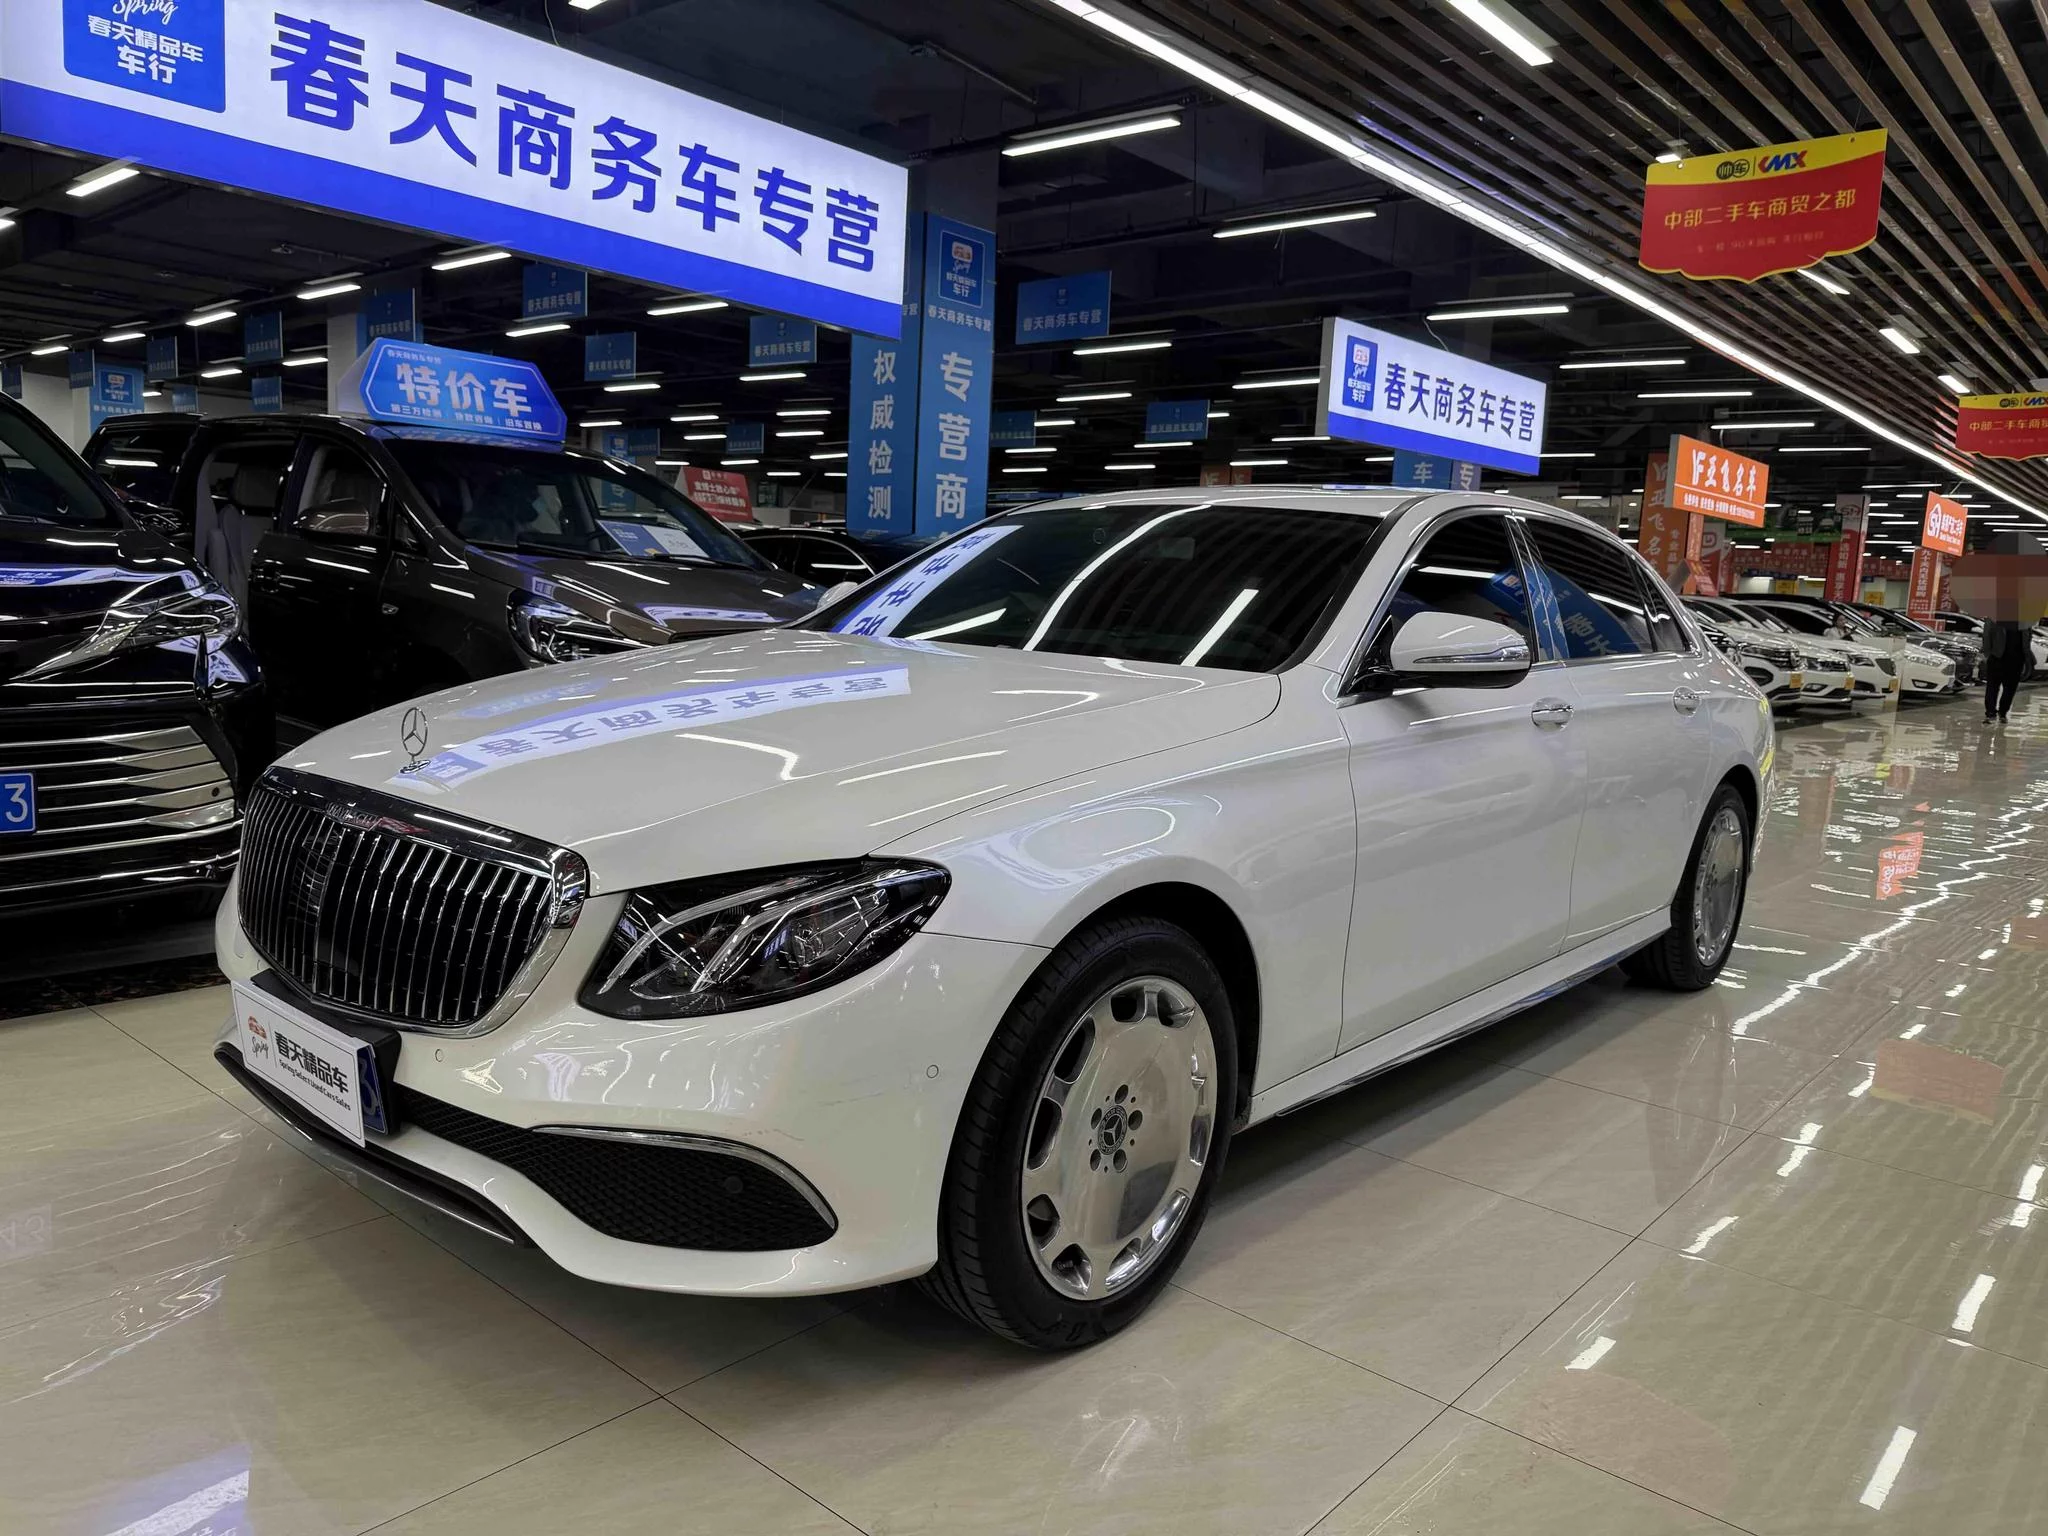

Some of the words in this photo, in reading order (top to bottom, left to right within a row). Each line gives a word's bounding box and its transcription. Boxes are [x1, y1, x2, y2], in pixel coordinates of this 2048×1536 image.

[88, 15, 204, 63] 春天精品车
[117, 44, 177, 85] 车行
[270, 12, 879, 273] 春天商务车专营
[1757, 150, 1809, 174] CMX
[1664, 188, 1856, 231] 中部二手车商贸之都
[928, 304, 992, 332] 春天商务车专营
[1023, 309, 1102, 332] 春天商务车专营
[396, 363, 532, 417] 特价车
[1384, 362, 1536, 442] 春天商务车专营
[867, 350, 896, 541] 权威检测
[935, 352, 974, 541] 专营商
[1412, 462, 1434, 484] 车
[4, 783, 28, 823] 3
[274, 1031, 349, 1094] 春天精品车
